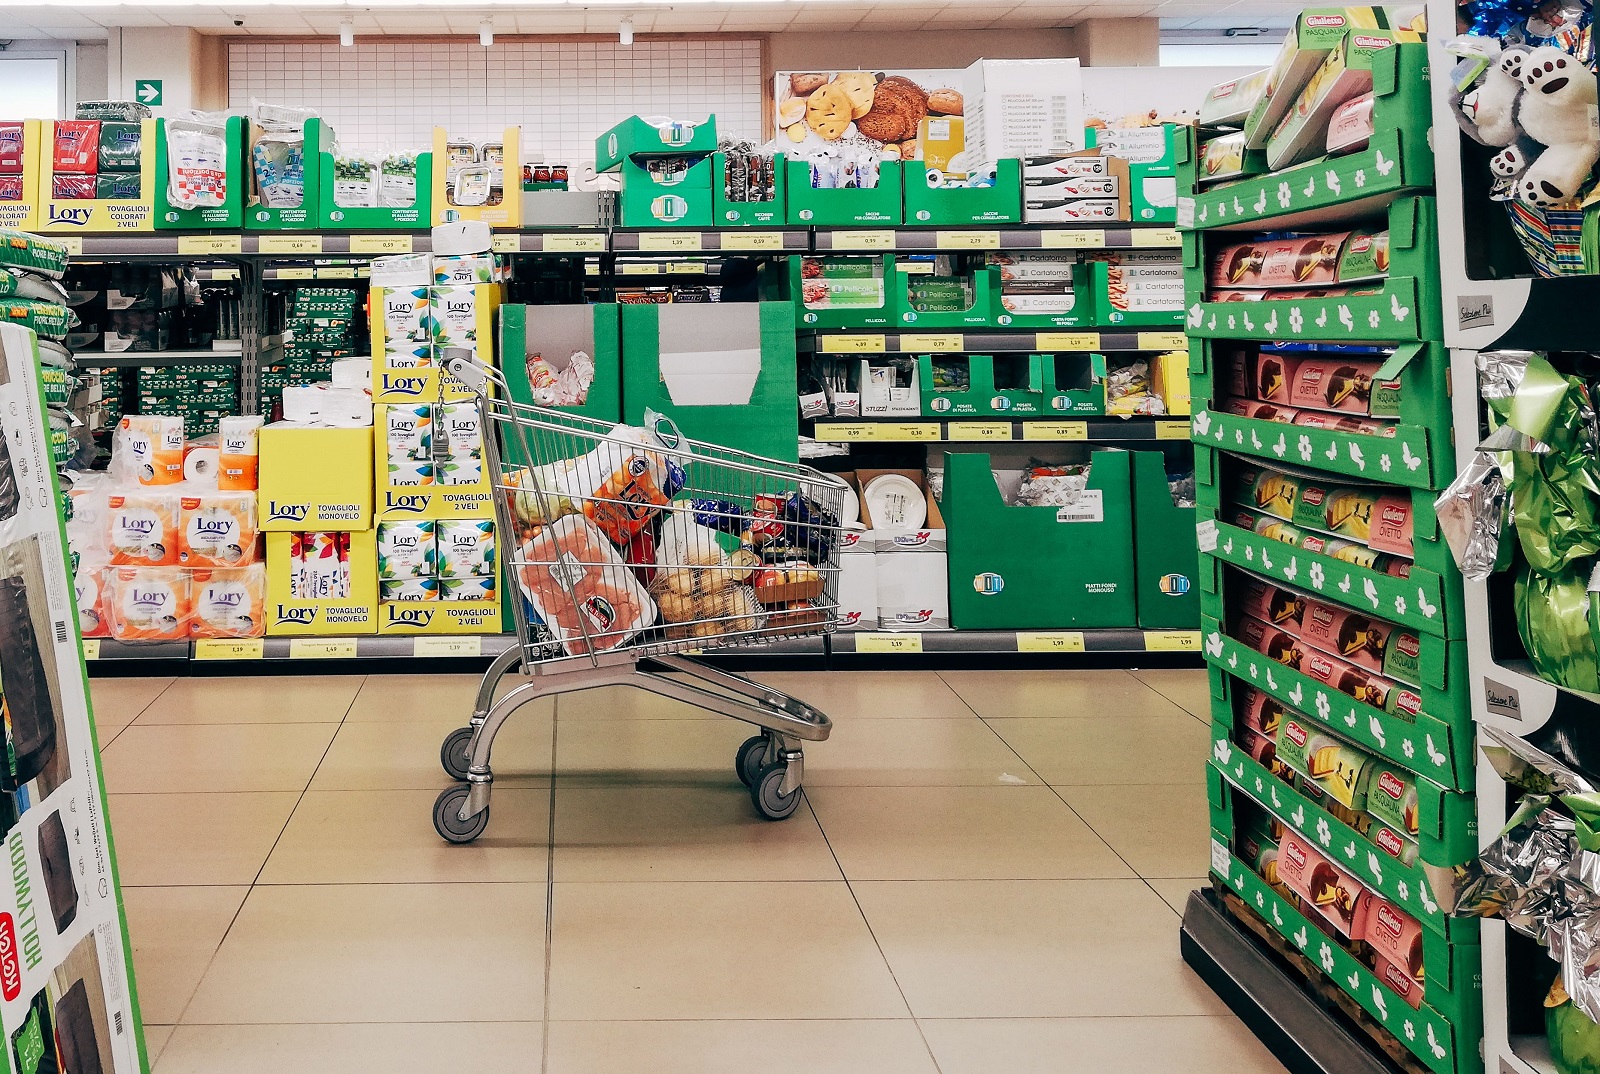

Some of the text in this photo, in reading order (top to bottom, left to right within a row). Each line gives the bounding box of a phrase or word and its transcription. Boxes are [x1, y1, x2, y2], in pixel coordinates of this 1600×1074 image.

[1306, 28, 1348, 36] PASQUALIN
[58, 130, 82, 142] Lory
[118, 131, 141, 143] Lory
[114, 184, 139, 198] Lory
[45, 204, 93, 230] Lory
[844, 284, 874, 292] Pellicola
[389, 301, 414, 314] Lory
[447, 300, 473, 314] Lory
[390, 359, 416, 370] Lory
[380, 374, 428, 398] Lory
[390, 419, 416, 432] Lory
[452, 419, 478, 432] Lory
[167, 434, 182, 446] Lory
[227, 438, 246, 452] Lory
[382, 491, 432, 515] Lory
[442, 493, 492, 502] TOVAGLIOLI
[266, 501, 311, 523] Lory
[461, 502, 479, 510] VELI
[122, 516, 156, 533] Lory
[195, 518, 234, 538] Lory
[1380, 526, 1402, 539] OVETTO
[393, 534, 418, 548] Lory
[453, 534, 479, 548] Lory
[319, 574, 330, 597] Lory
[133, 589, 169, 606] Lory
[209, 589, 244, 606] Lory
[398, 592, 424, 600] Lory
[458, 592, 484, 600] Lory
[274, 604, 318, 626] Lory
[326, 607, 369, 615] TOVAGLIOLI
[386, 604, 436, 629] Lory
[446, 609, 496, 617] TOVAGLIOLI
[326, 615, 368, 623] MONOVELO
[10, 831, 42, 972] HOLLYWOOD
[1376, 927, 1398, 951] OVETTO
